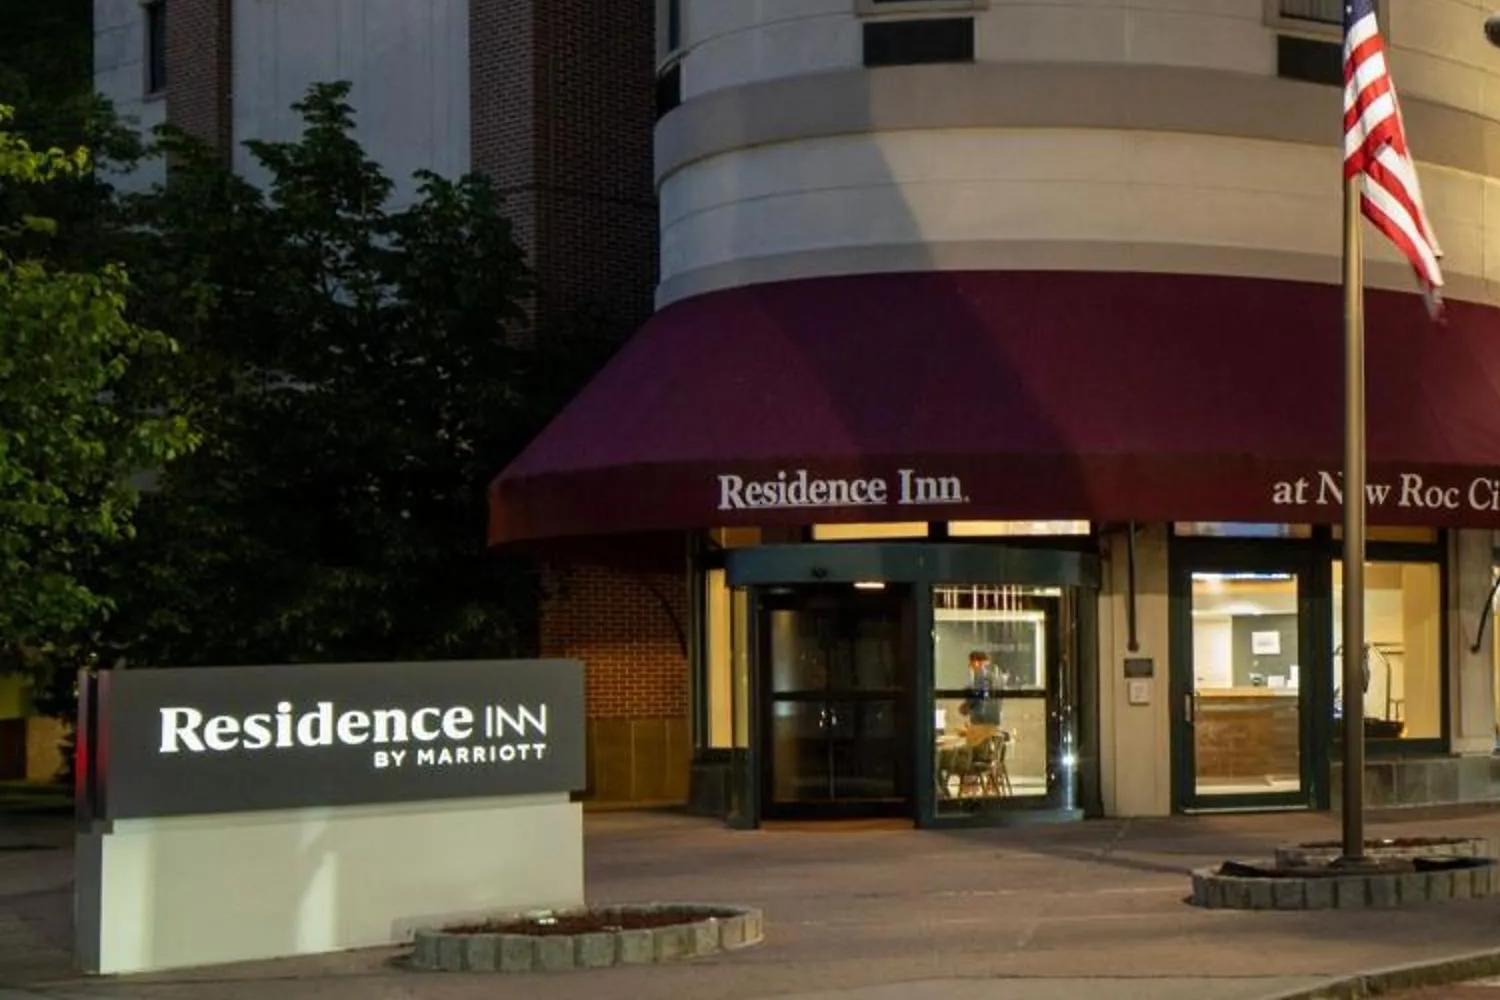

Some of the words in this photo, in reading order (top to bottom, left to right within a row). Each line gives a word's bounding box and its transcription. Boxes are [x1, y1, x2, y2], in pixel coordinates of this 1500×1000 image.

[717, 469, 887, 510] Residence
[897, 468, 963, 505] Inn
[1272, 477, 1309, 505] at
[1316, 470, 1391, 505] Nw
[1399, 472, 1460, 509] Roc
[159, 701, 474, 753] Residence
[485, 703, 548, 738] INN
[373, 750, 407, 768] BY
[416, 743, 547, 766] MARRIOTT
